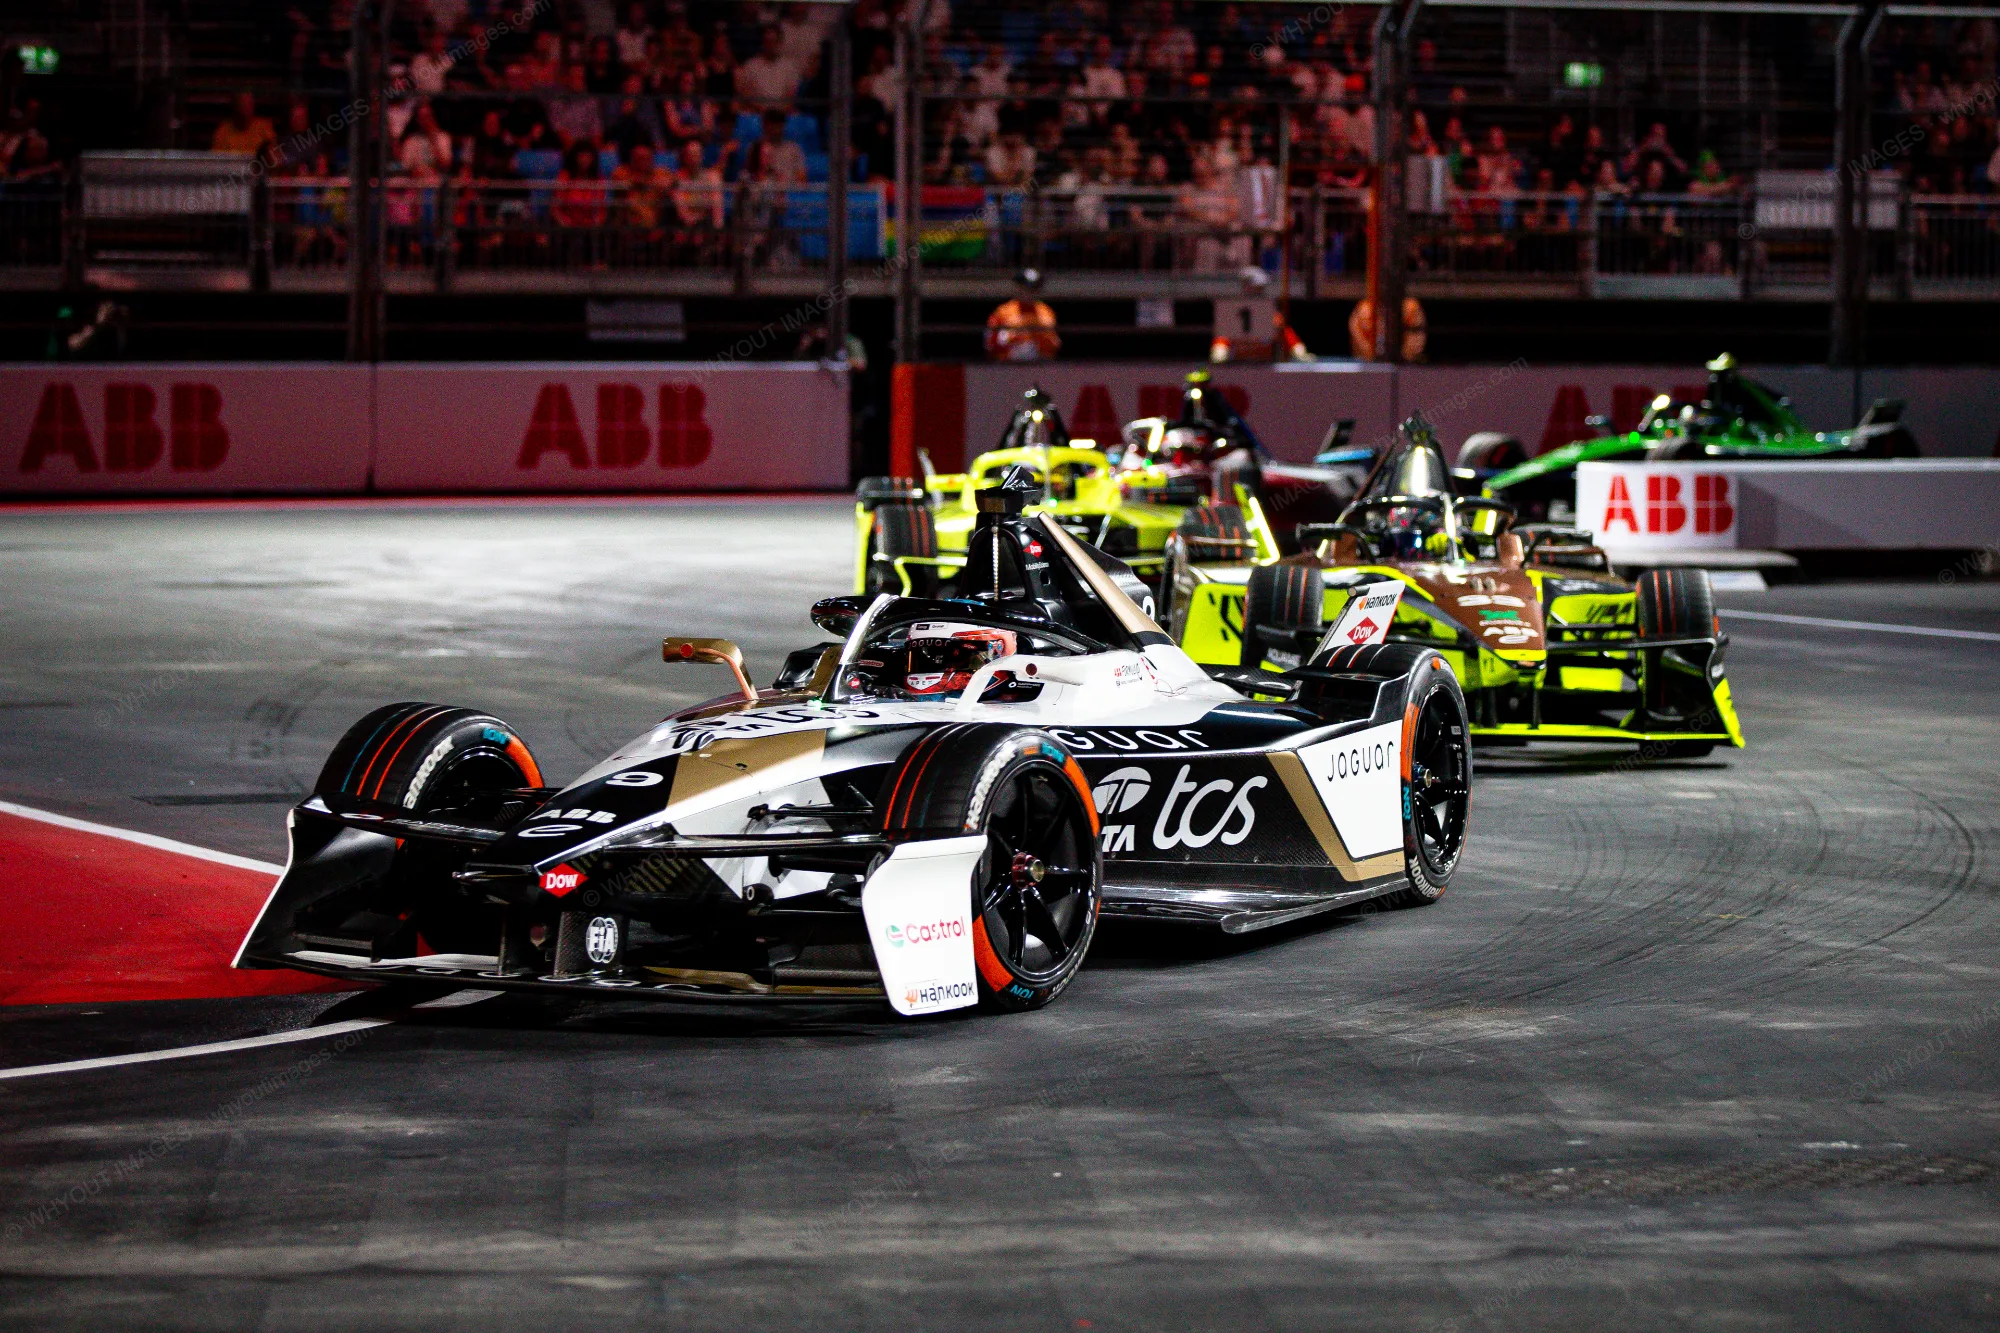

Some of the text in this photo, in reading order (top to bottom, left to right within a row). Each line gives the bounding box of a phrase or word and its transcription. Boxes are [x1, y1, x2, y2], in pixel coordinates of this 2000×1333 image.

[20, 382, 231, 473] ABB
[516, 382, 713, 470] ABB
[1603, 475, 1735, 534] ABB
[605, 771, 664, 787] 9
[529, 808, 617, 824] ABB
[1152, 764, 1268, 850] tcs
[1101, 825, 1135, 852] TA
[906, 917, 966, 943] Castrol
